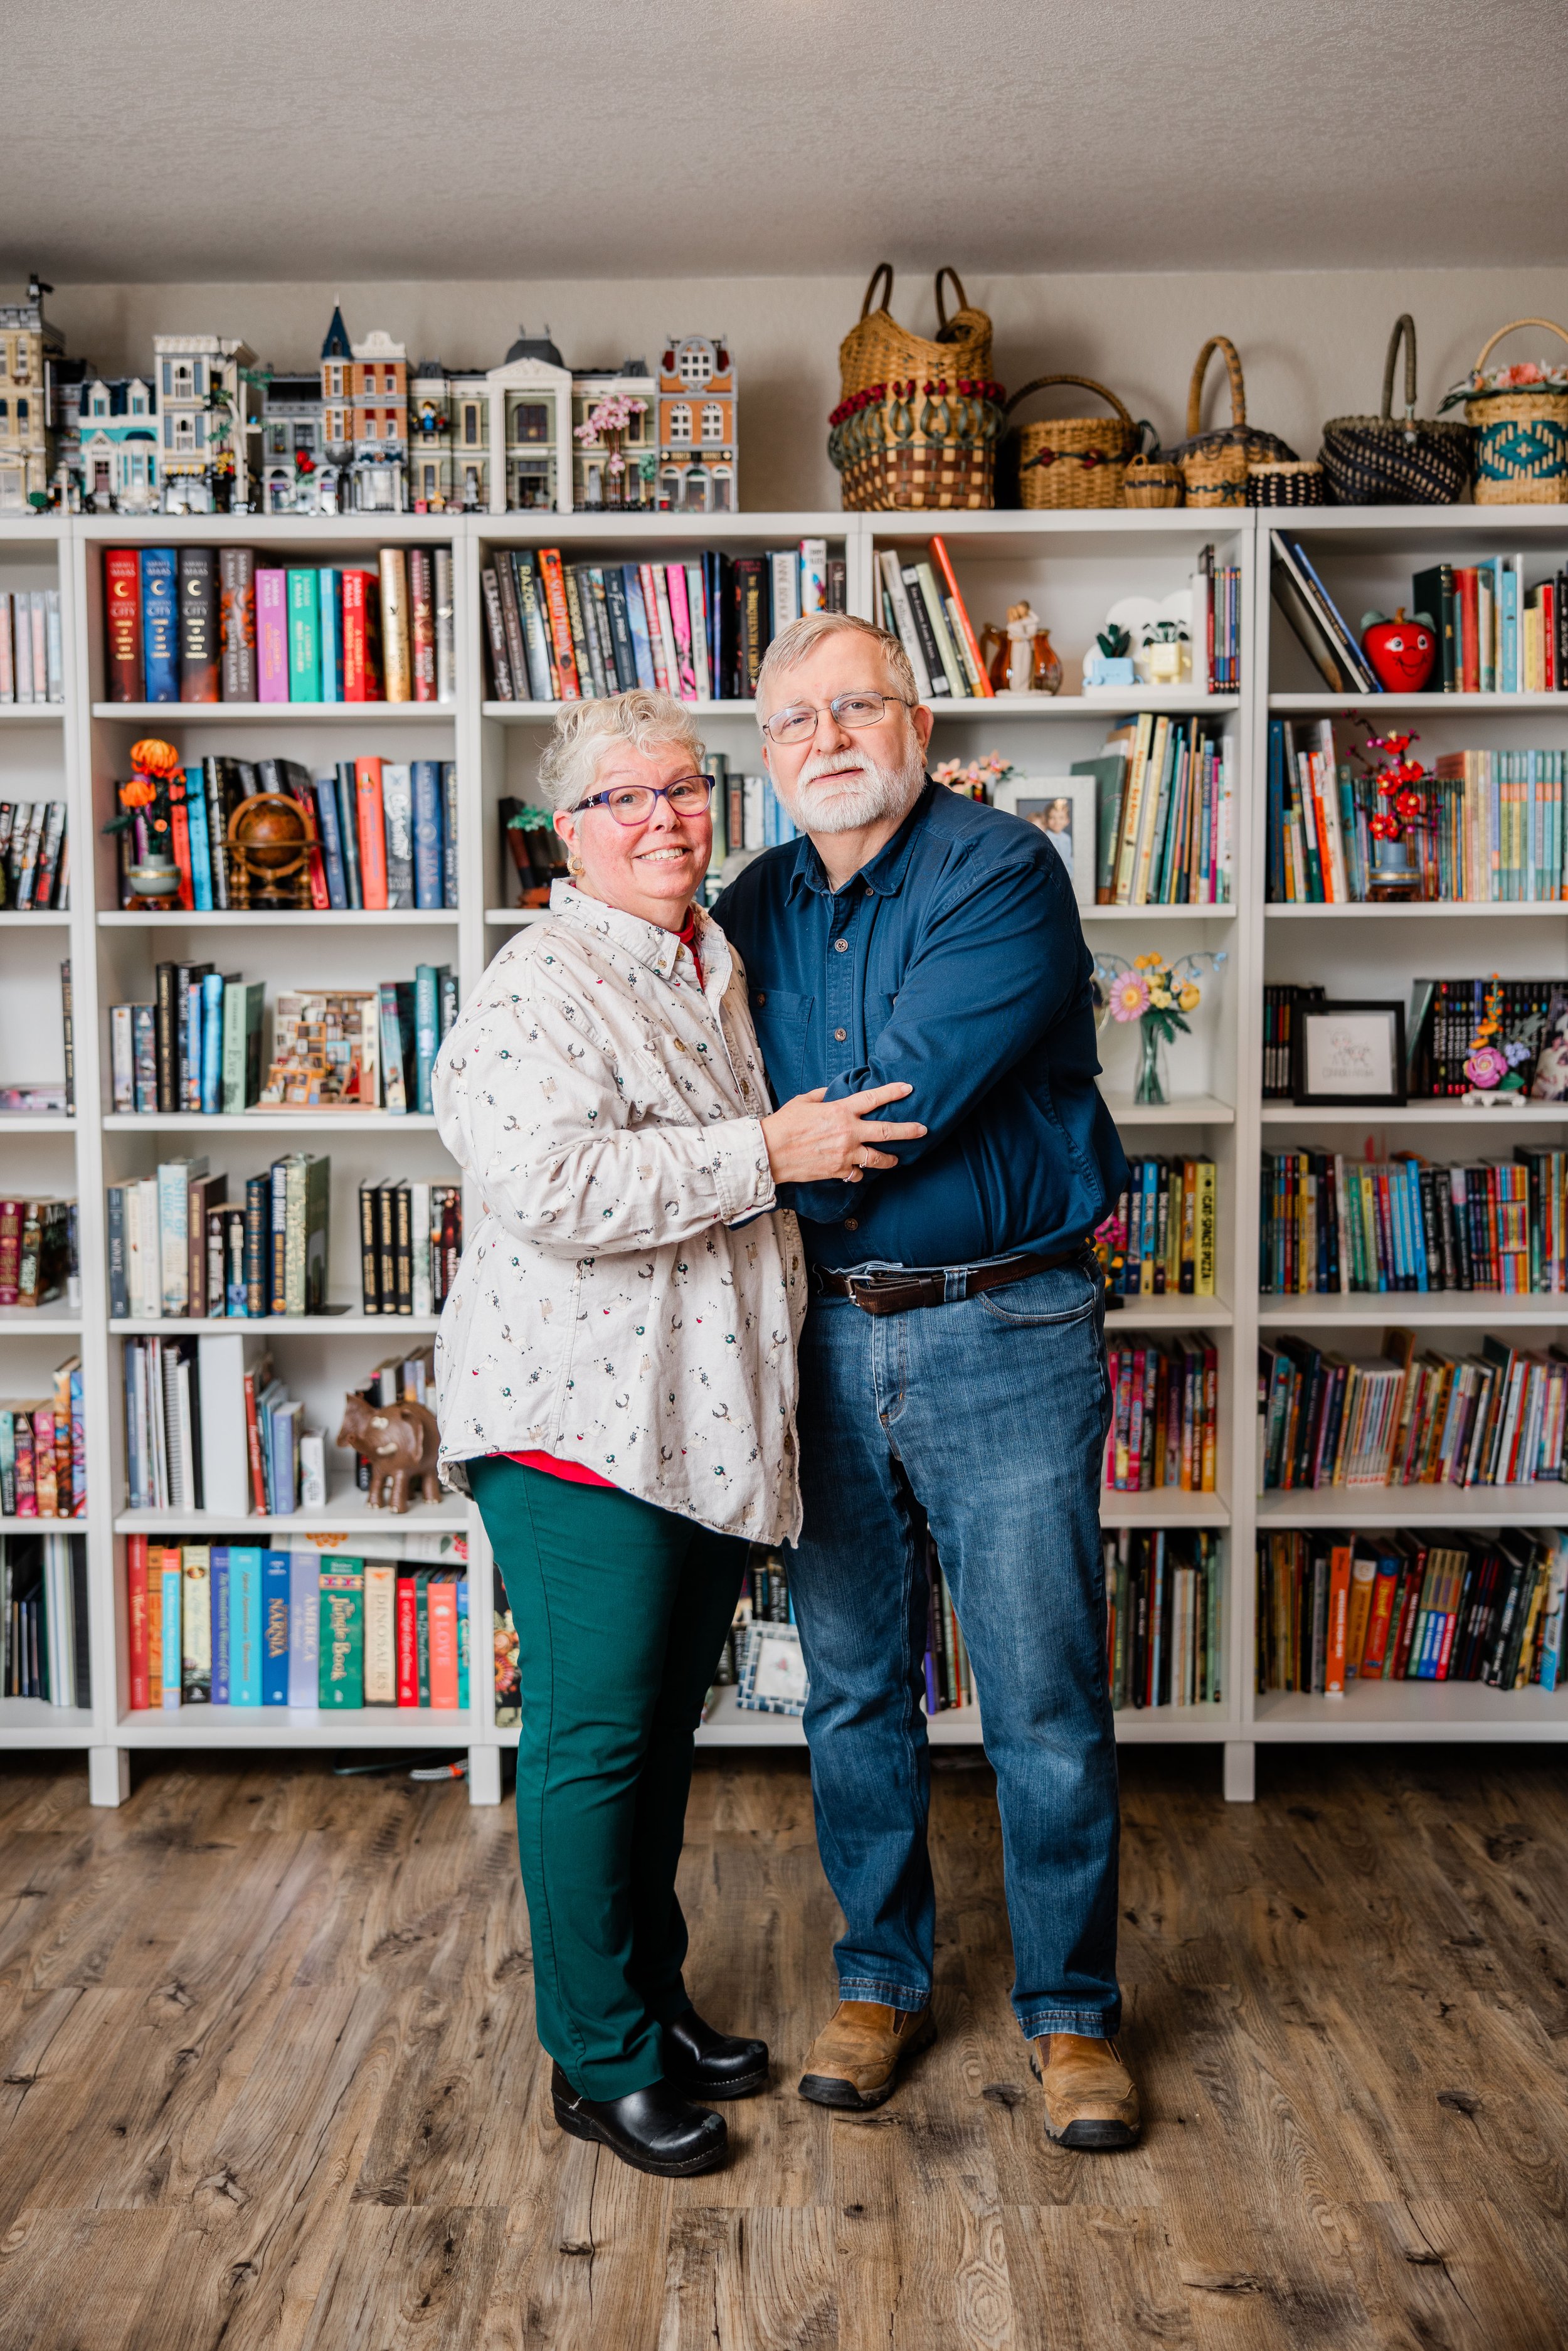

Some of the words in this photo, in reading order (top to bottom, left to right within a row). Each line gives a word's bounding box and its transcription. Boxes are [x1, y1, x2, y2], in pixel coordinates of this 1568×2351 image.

[273, 1167, 287, 1197] DAVID
[273, 1197, 287, 1231] DRAKE
[1201, 1218, 1213, 1248] SPACE
[1201, 1251, 1213, 1279] PIZZA
[264, 1598, 285, 1658] NARNIA
[304, 1593, 317, 1662] AMERICA
[327, 1594, 351, 1639] Jungle
[344, 1603, 355, 1618] The
[330, 1641, 352, 1681] Book
[375, 1593, 389, 1689] DINOSAURS
[435, 1621, 452, 1667] LOVE
